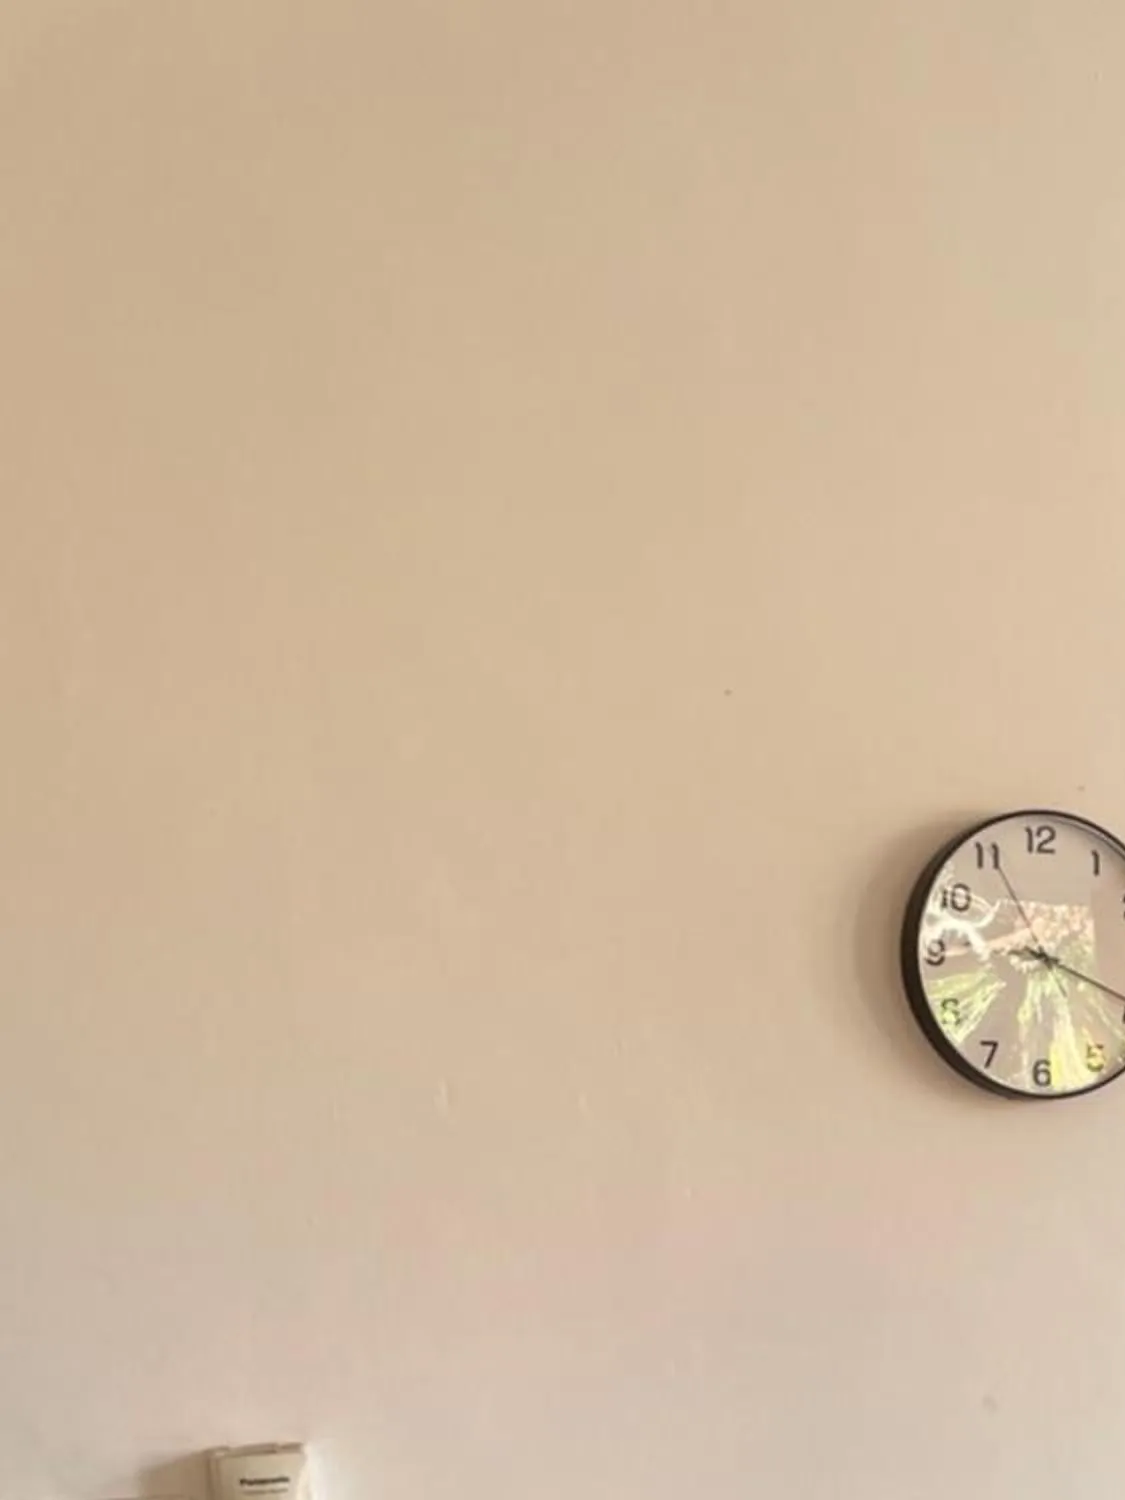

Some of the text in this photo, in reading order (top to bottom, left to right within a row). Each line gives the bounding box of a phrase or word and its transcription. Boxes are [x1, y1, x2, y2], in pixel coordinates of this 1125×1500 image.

[1025, 826, 1056, 853] 12
[975, 842, 1000, 869] 11
[1091, 850, 1100, 876] 1
[941, 884, 971, 912] 10
[926, 939, 945, 966] 9
[941, 998, 961, 1026] 8
[980, 1041, 998, 1068] 7
[1086, 1044, 1104, 1072] 5
[1032, 1059, 1052, 1086] 6
